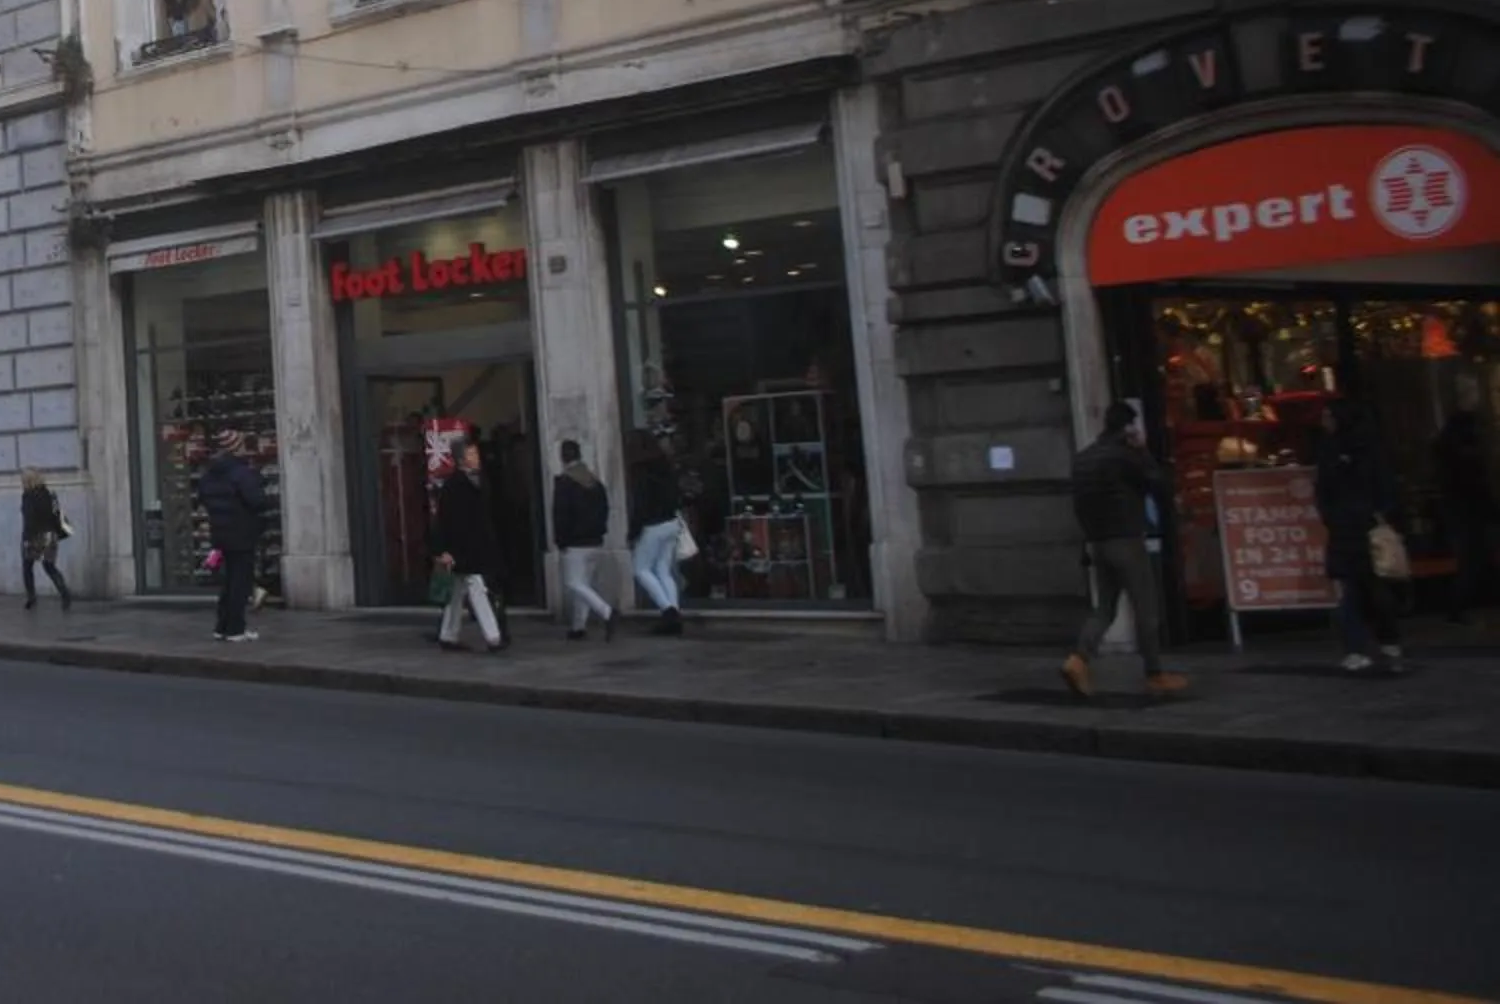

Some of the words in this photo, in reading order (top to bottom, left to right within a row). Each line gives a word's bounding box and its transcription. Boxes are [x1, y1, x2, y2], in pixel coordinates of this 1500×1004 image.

[1123, 184, 1355, 245] expert
[331, 256, 404, 301] Foot
[410, 242, 525, 292] Locker
[1225, 504, 1319, 524] STAMPA
[1243, 526, 1307, 544] FOTO
[1238, 578, 1260, 602] 9
